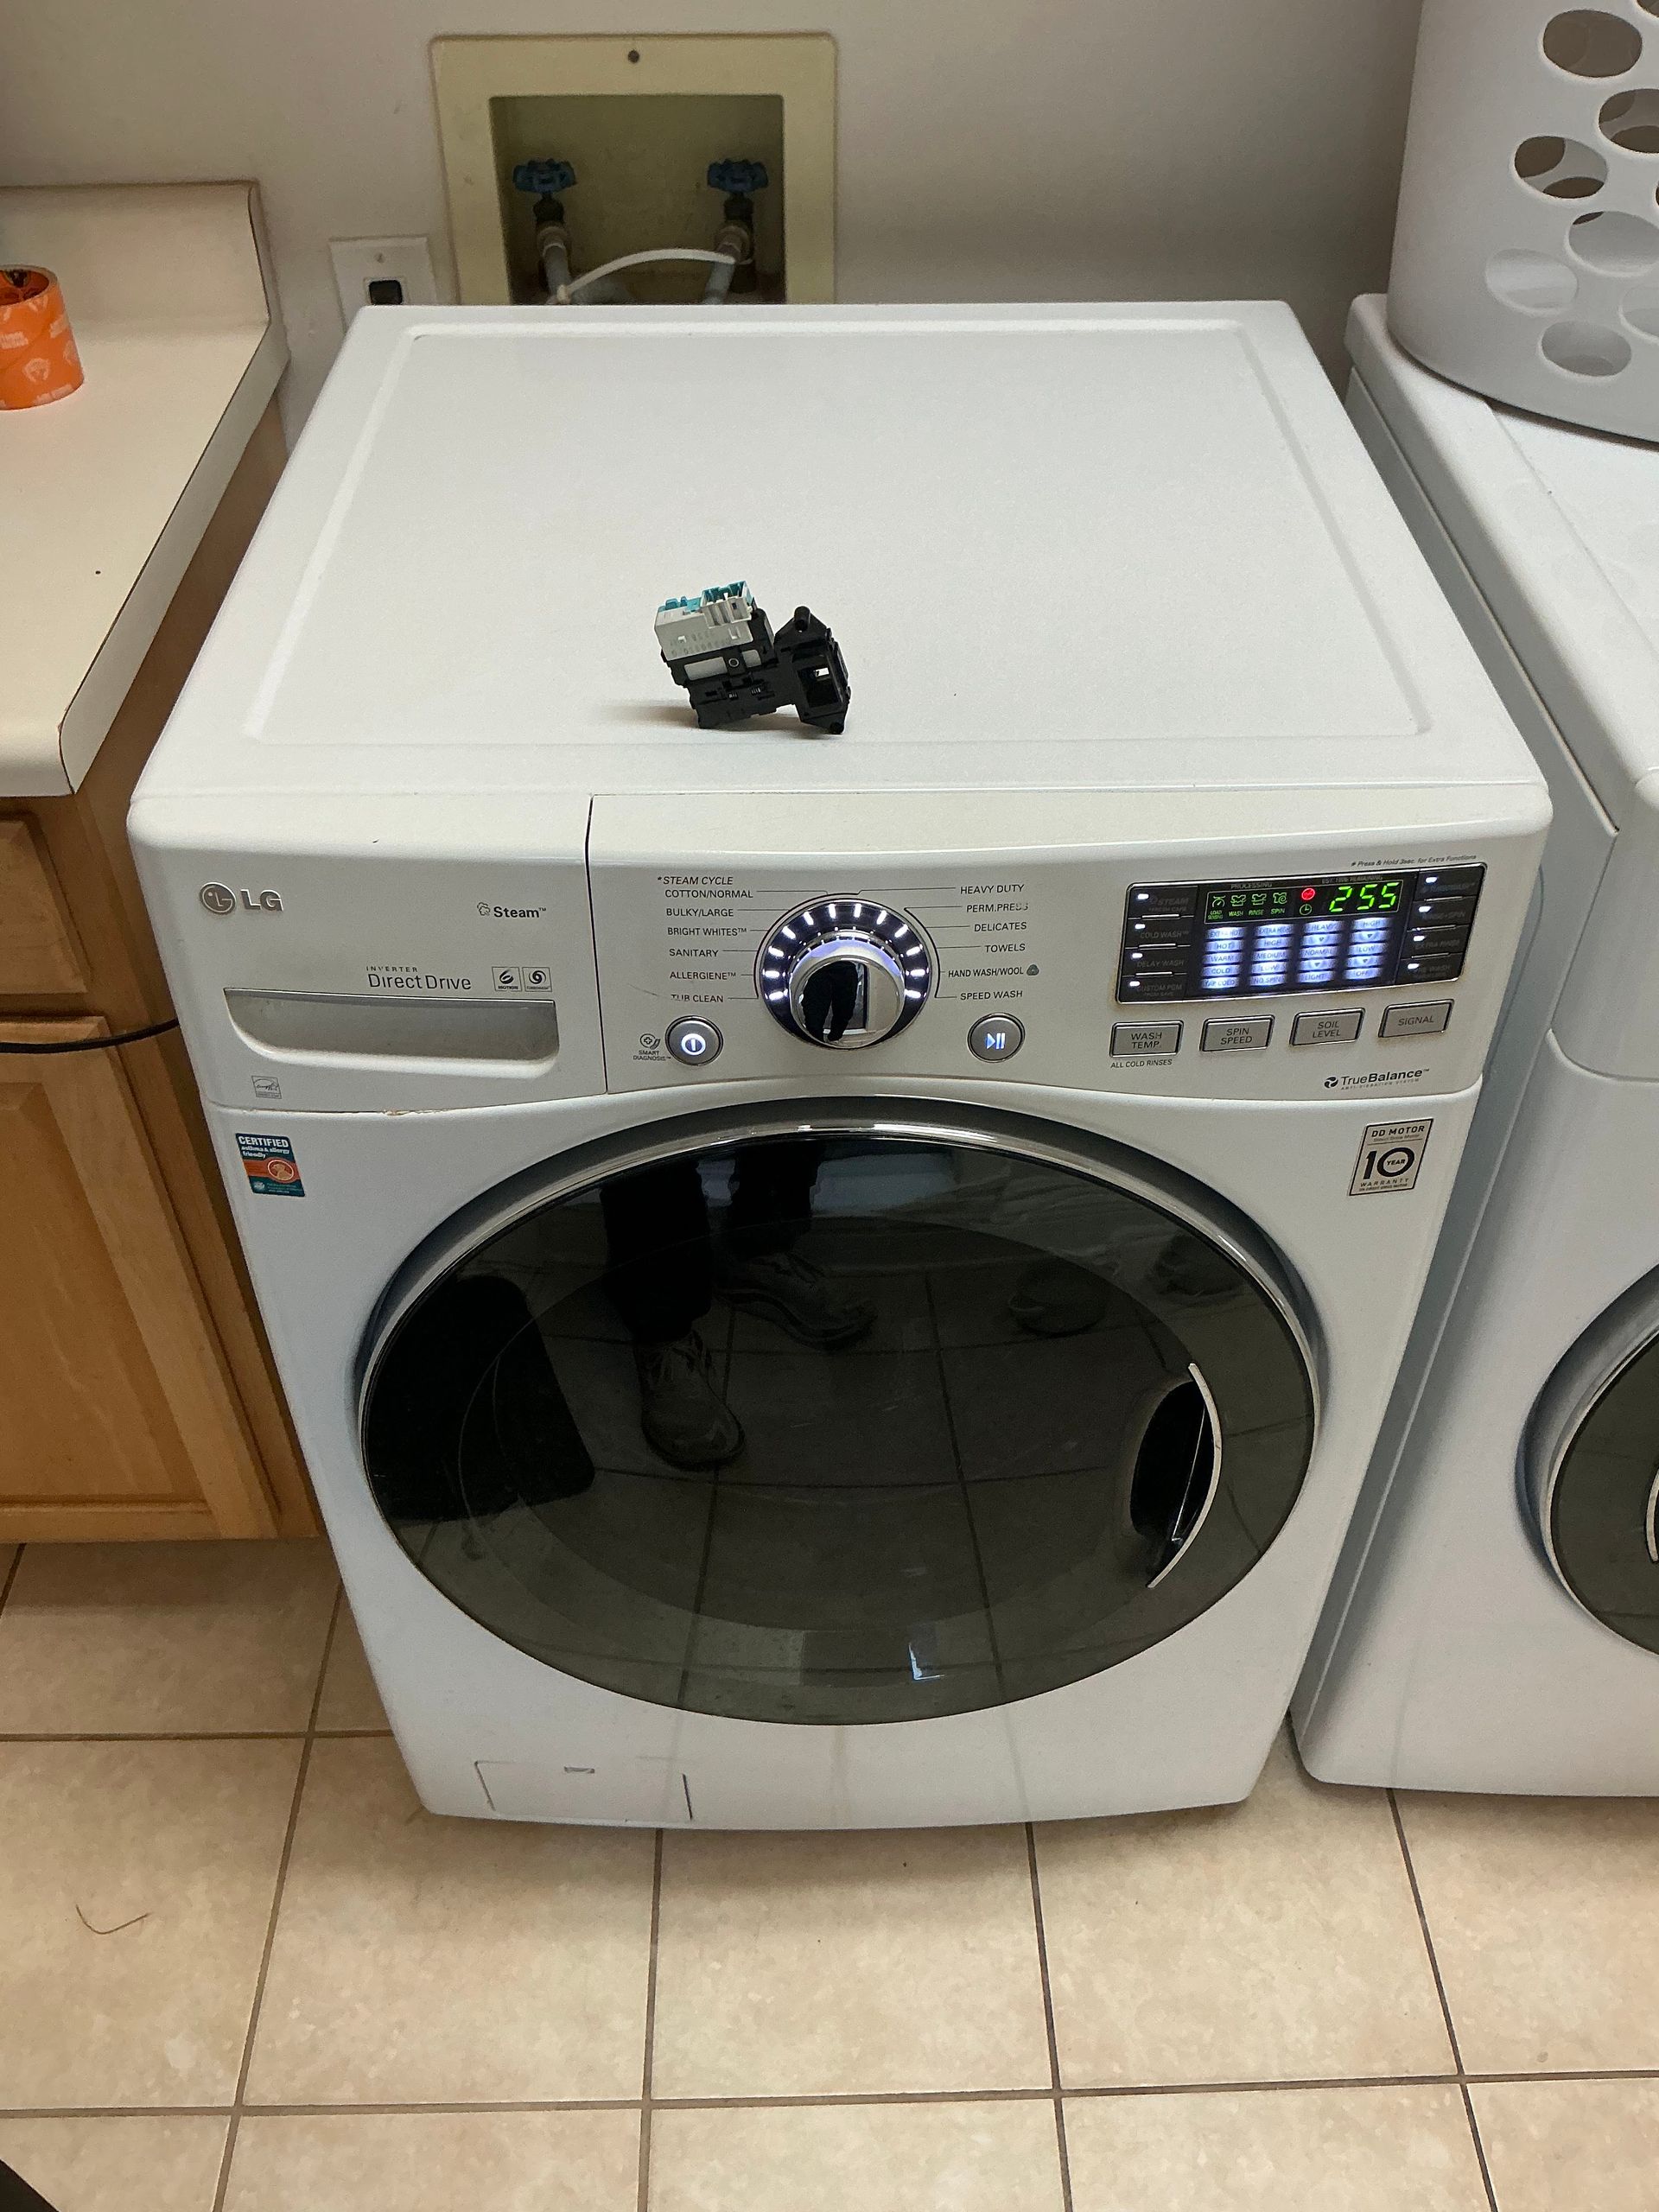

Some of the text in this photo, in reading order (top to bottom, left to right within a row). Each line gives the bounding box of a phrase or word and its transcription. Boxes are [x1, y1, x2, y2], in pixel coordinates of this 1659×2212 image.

[701, 876, 734, 886] CYCLE
[664, 889, 753, 899] COTTON/NORMAL
[960, 884, 1025, 894] HEAVY DUTY
[240, 888, 283, 912] LG
[1329, 881, 1400, 912] 255
[666, 908, 734, 918] BULKY/LARGE
[974, 921, 1027, 931] DELICATES
[667, 927, 701, 936] BRIGHT
[669, 948, 719, 957] SANITARY
[984, 943, 1026, 953] TOWELS
[948, 966, 1024, 978] HAND WASH/WOOL
[368, 974, 471, 990] Direct Drive
[693, 994, 724, 1002] CLEAN
[960, 990, 1023, 1001] SPEED WASH
[1398, 1015, 1434, 1027] SIGNAL
[1226, 1027, 1249, 1036] SPIN
[1220, 1036, 1252, 1045] SPEED
[1389, 1125, 1425, 1135] MOTOR
[238, 1135, 289, 1147] CERTIFIED
[1363, 1147, 1415, 1179] 10
[1360, 1178, 1409, 1187] WARRANTY
